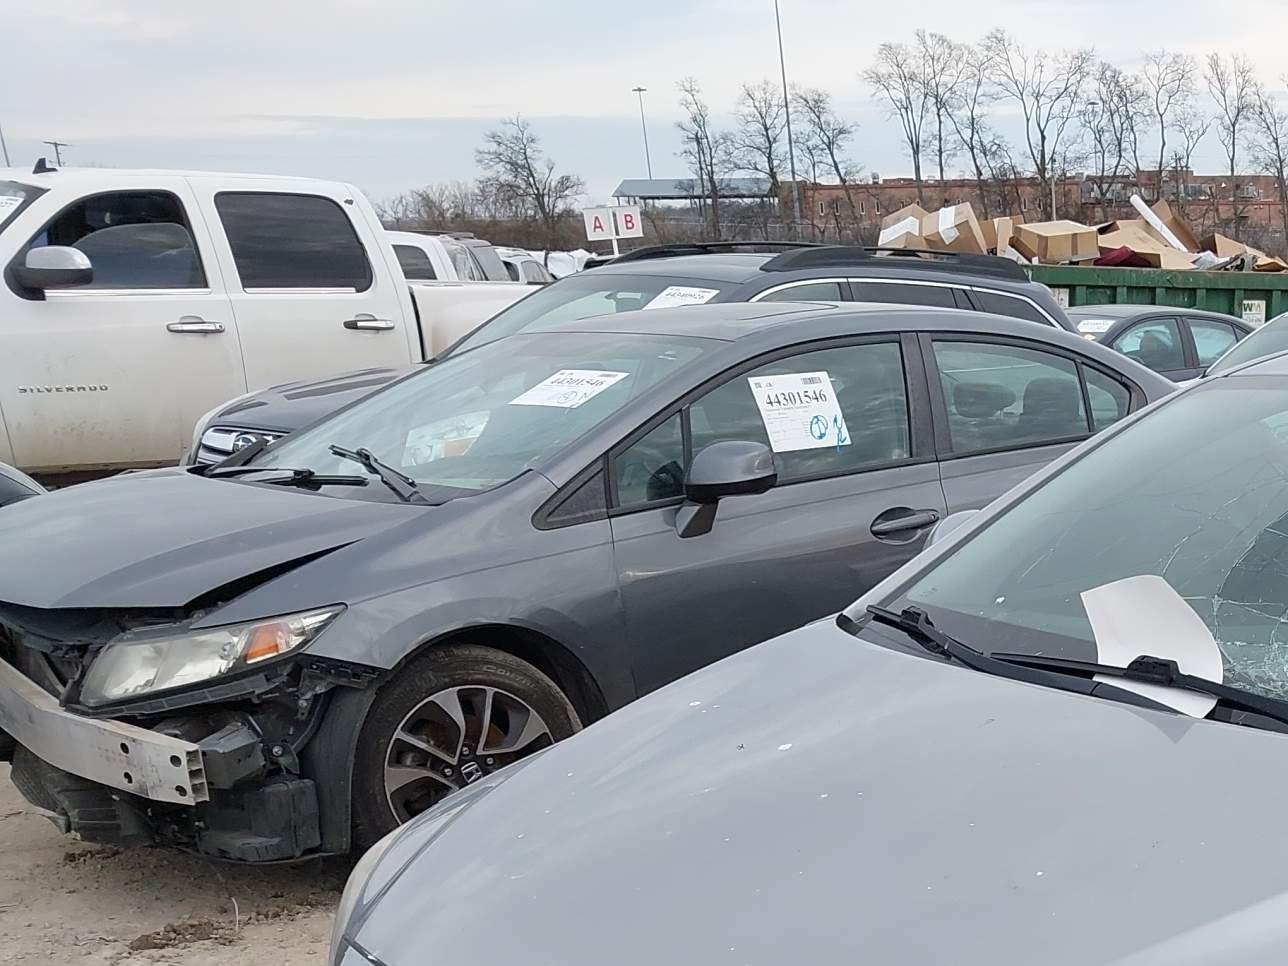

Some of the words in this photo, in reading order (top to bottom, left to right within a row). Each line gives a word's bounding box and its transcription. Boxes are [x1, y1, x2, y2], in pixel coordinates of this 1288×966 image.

[593, 216, 604, 232] A
[624, 214, 635, 230] B
[18, 384, 109, 394] SILVERADO
[765, 389, 828, 408] 44301546
